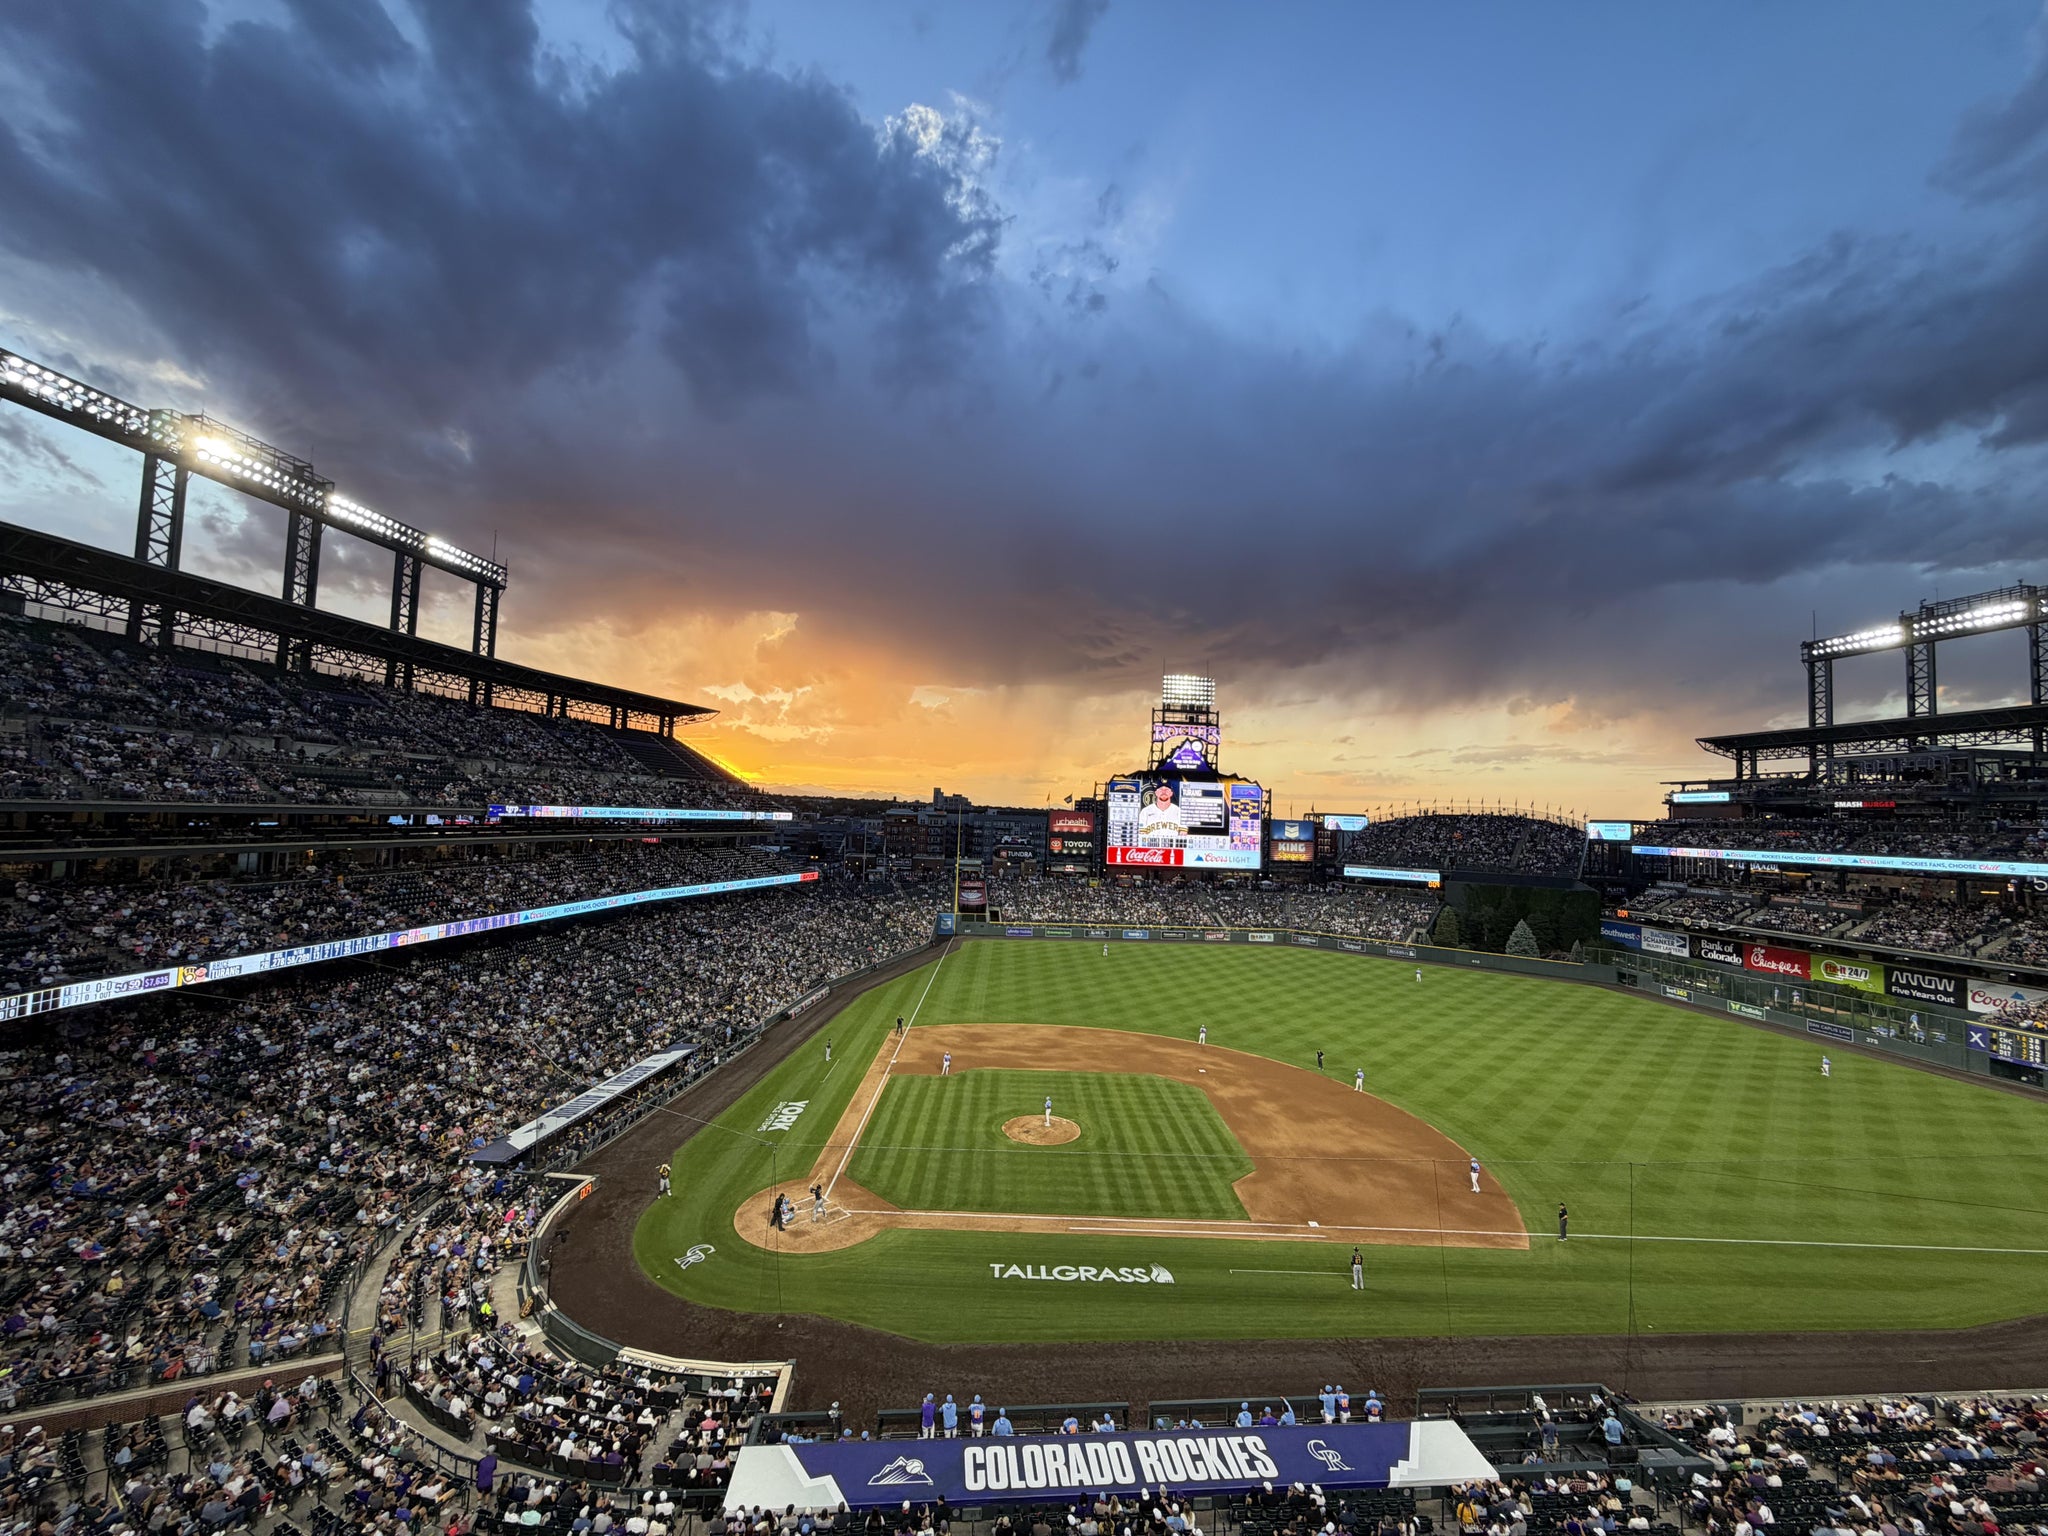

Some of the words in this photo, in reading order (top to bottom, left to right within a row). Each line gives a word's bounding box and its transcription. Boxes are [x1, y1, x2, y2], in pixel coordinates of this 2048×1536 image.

[1153, 725, 1221, 744] ROCKIES
[1056, 817, 1088, 826] uchealth
[1064, 840, 1093, 848] TOYOTA
[1278, 843, 1306, 852] KING
[1007, 850, 1033, 858] TUNDRA
[1126, 848, 1165, 863] Coca-Cola
[1204, 852, 1228, 863] Coors
[1901, 860, 1928, 868] ROCKIES
[1928, 861, 1948, 869] FANS,
[1948, 862, 1976, 870] CHOOSE
[1978, 864, 2000, 872] Chill
[1600, 927, 1635, 940] Southwest
[1643, 935, 1676, 947] SCHANKER
[1701, 939, 1722, 951] Bank
[1724, 943, 1734, 953] of
[1701, 949, 1742, 964] Colorado
[212, 966, 241, 979] TURANG
[1848, 967, 1868, 979] 24/7
[96, 981, 112, 993] 0-0
[144, 975, 169, 989] $7,635
[1891, 970, 1955, 992] ARROW
[99, 991, 111, 999] OUT
[1666, 986, 1688, 997] bet365
[1891, 985, 1910, 995] Five
[1911, 989, 1935, 1001] Years
[1937, 993, 1955, 1004] Out
[1866, 1037, 1879, 1045] 375
[767, 1100, 810, 1132] YORK
[989, 1263, 1150, 1284] TALLGRASS
[964, 1440, 1138, 1492] COLORADO
[1135, 1435, 1280, 1484] ROCKIES
